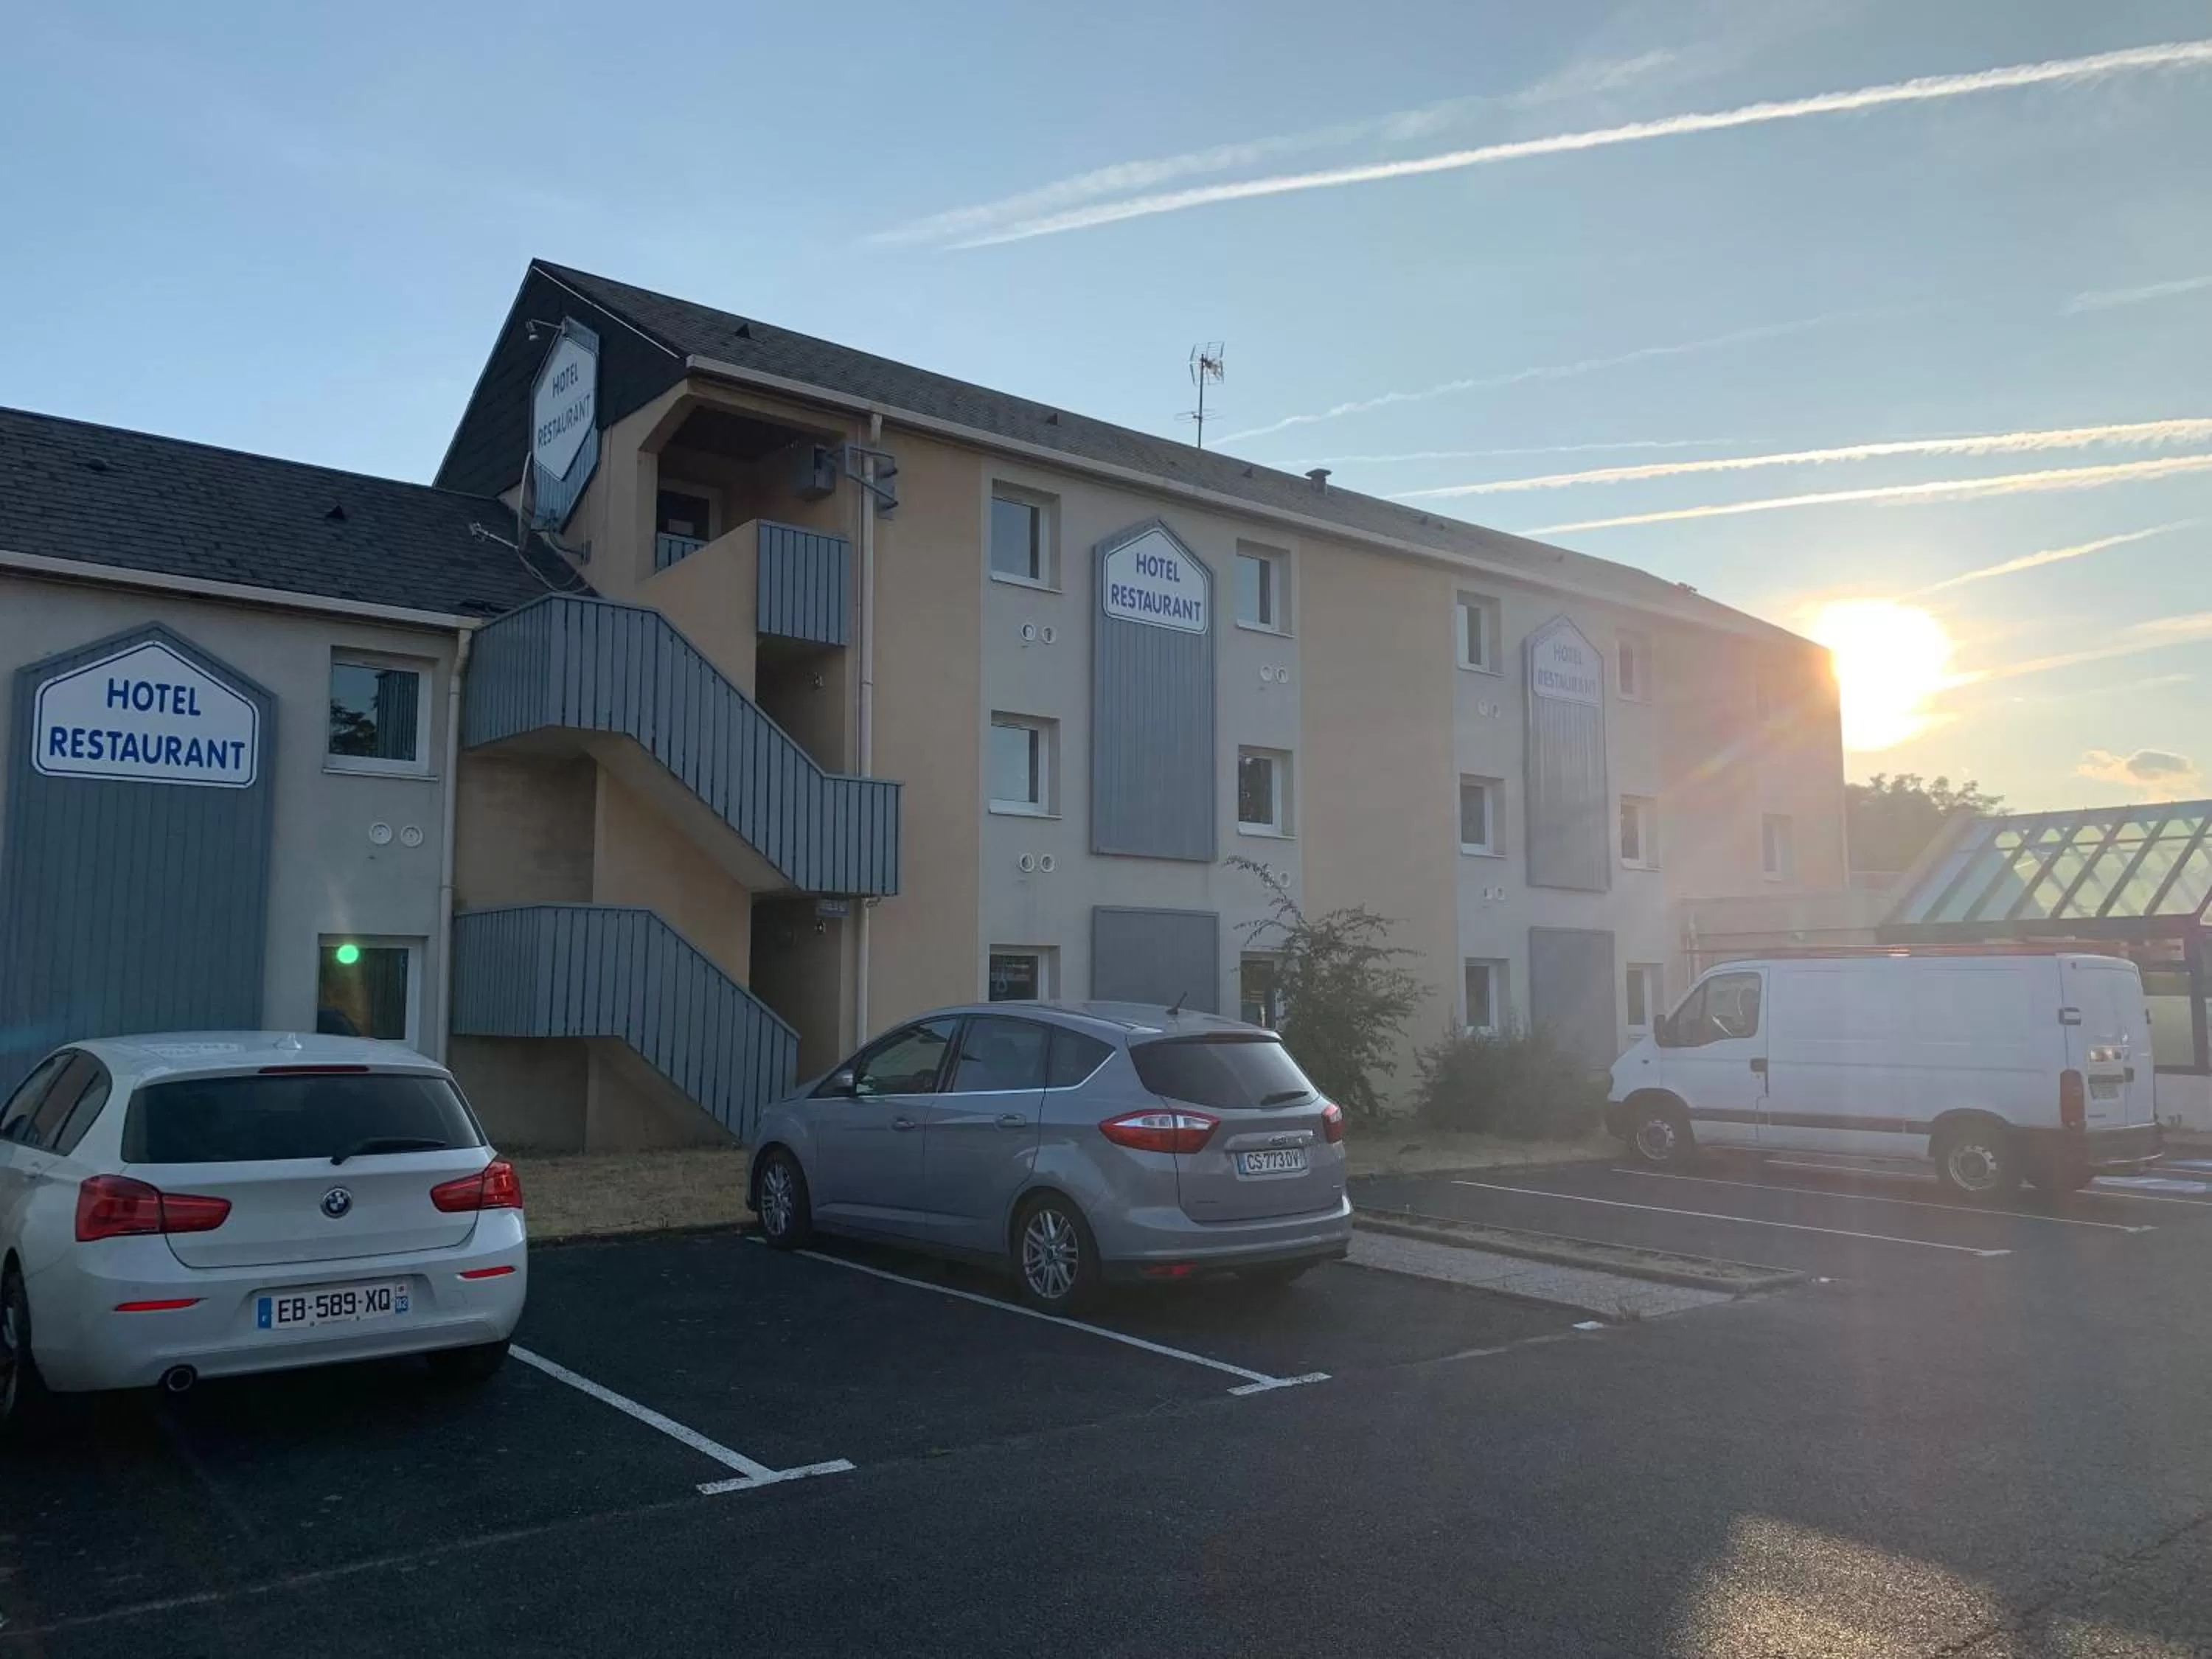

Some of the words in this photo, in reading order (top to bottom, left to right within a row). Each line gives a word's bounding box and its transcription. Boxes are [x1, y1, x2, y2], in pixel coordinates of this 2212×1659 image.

[553, 362, 579, 398] HOTEL
[538, 394, 591, 448] RESTAURANT
[1136, 553, 1180, 582] HOTEL
[1111, 584, 1201, 622] RESTAURANT
[107, 678, 201, 717] HOTEL
[49, 726, 245, 770] RESTAURANT
